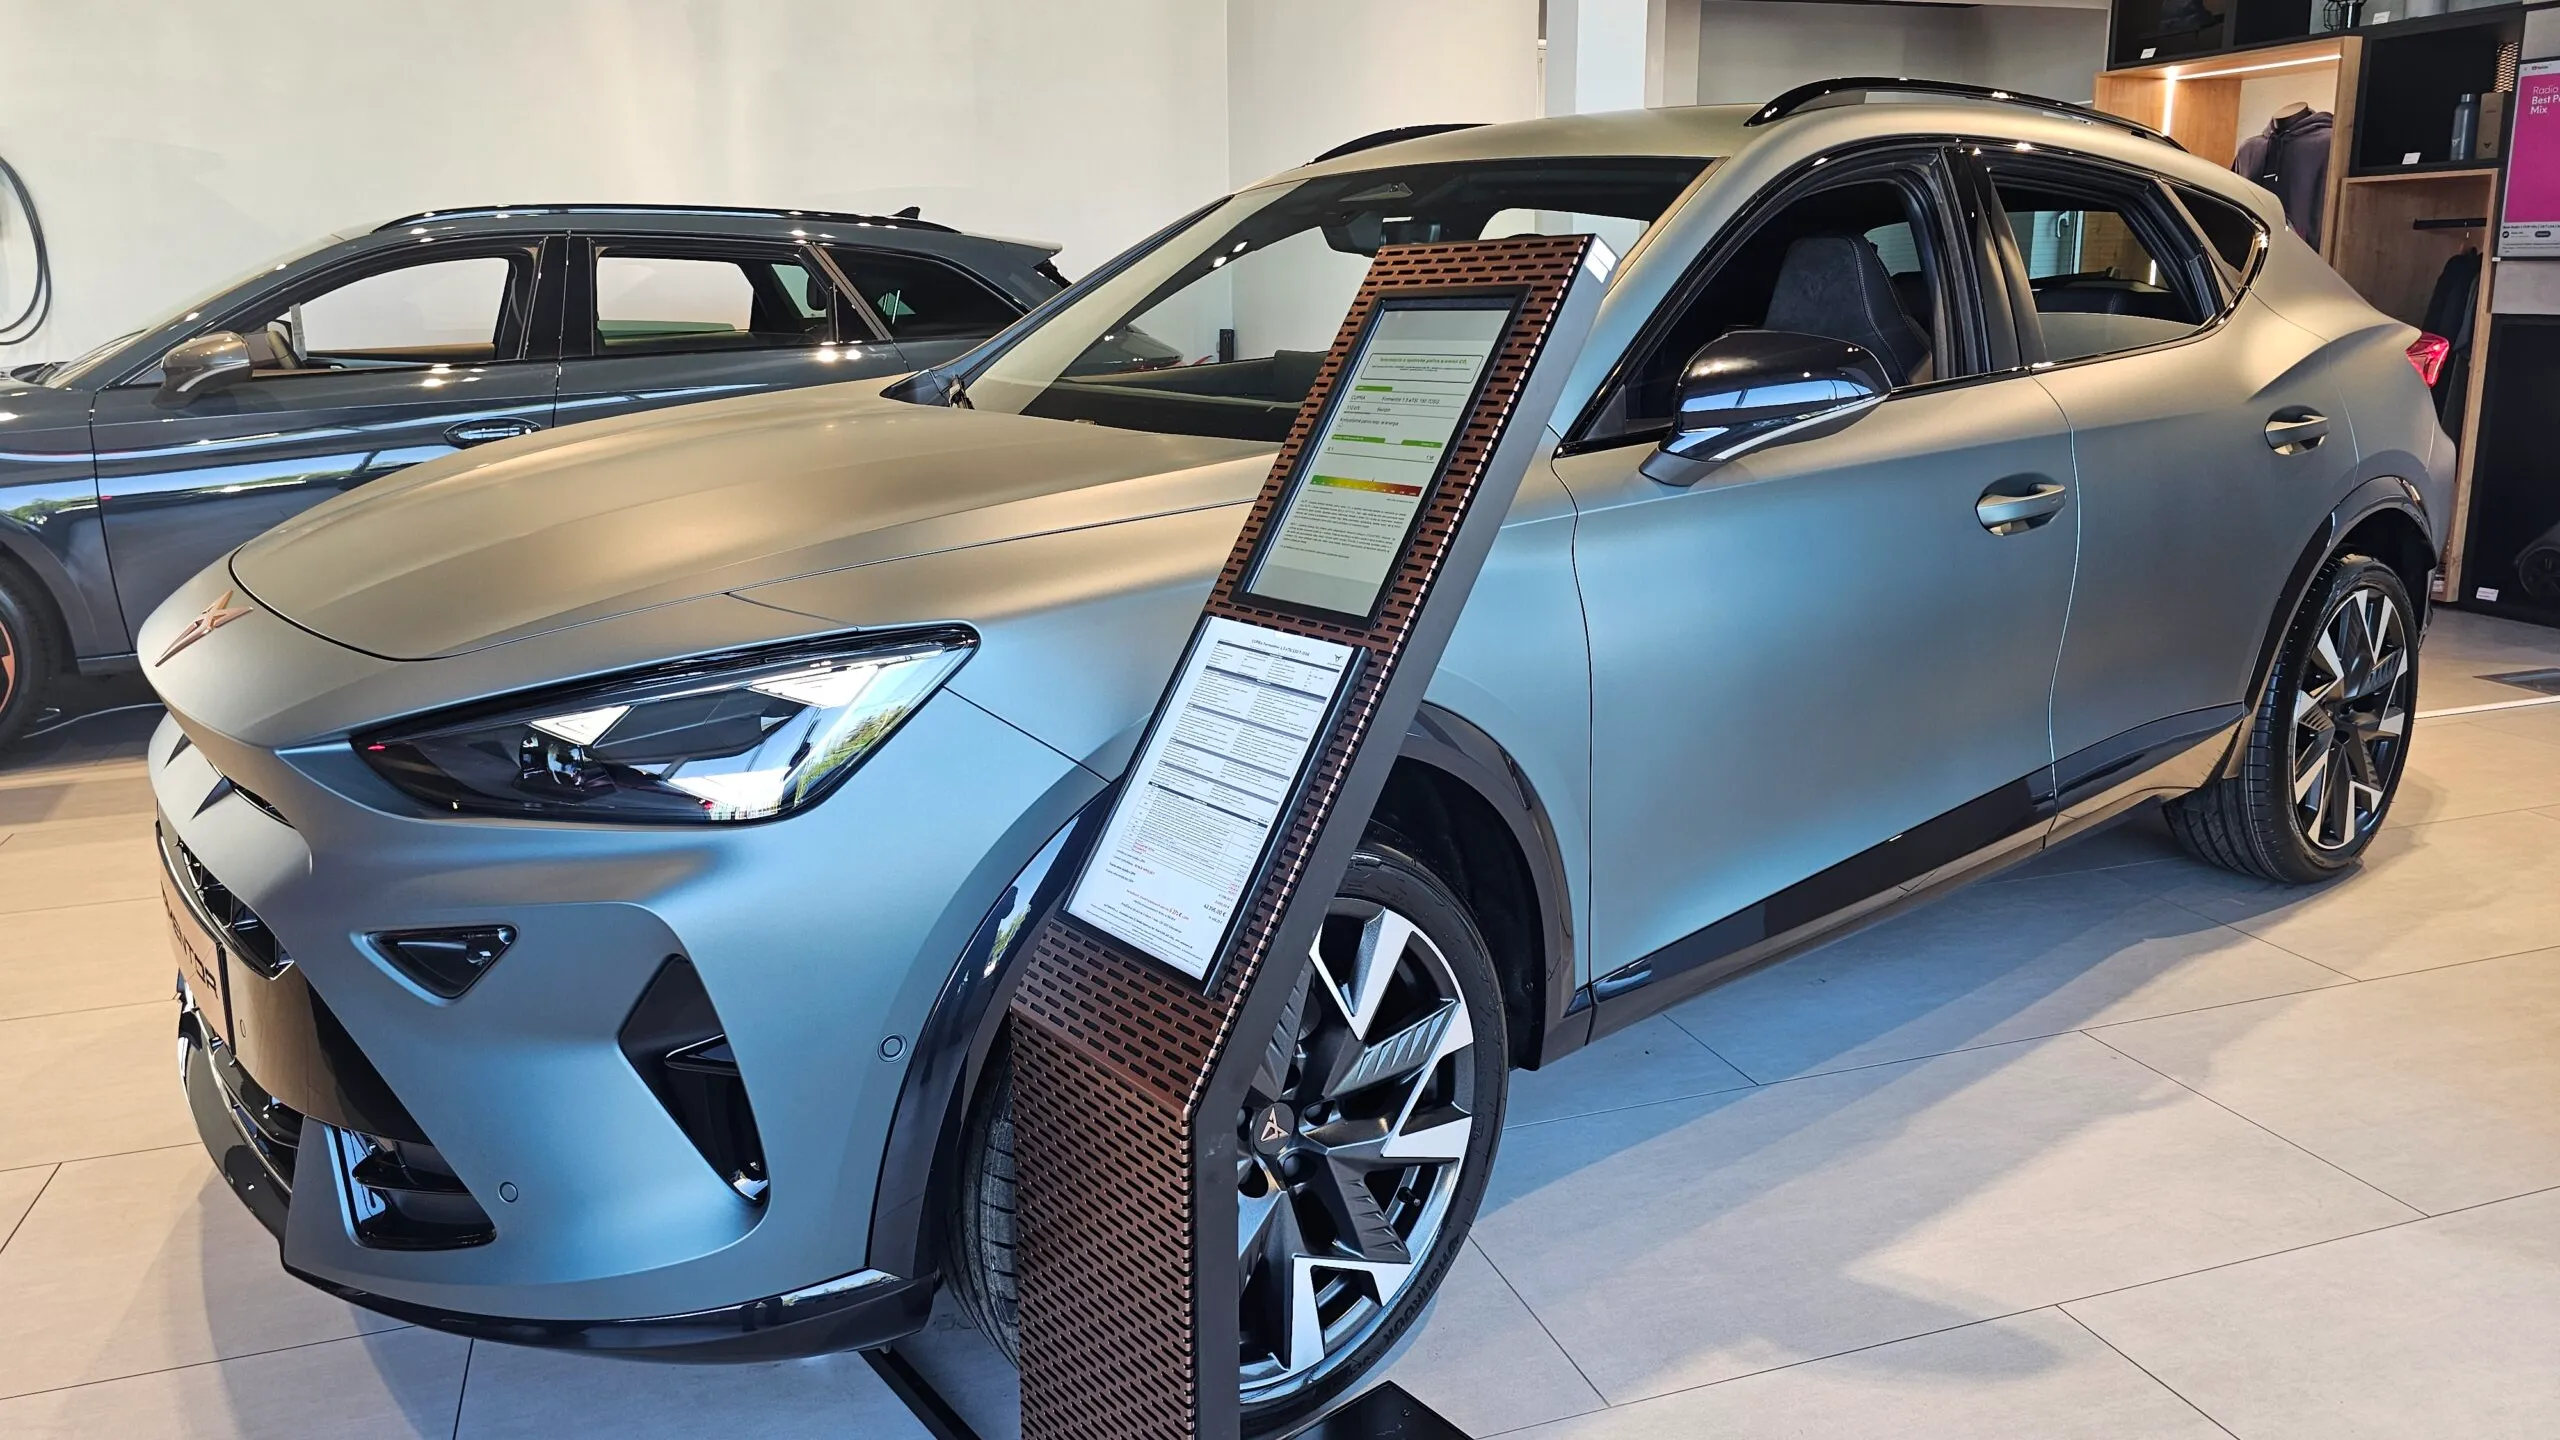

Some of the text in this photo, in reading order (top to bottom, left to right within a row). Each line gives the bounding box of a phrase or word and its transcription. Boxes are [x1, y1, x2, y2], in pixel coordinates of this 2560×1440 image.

[2533, 85, 2559, 95] Radio
[2531, 95, 2551, 105] Best
[2530, 105, 2548, 115] Mix
